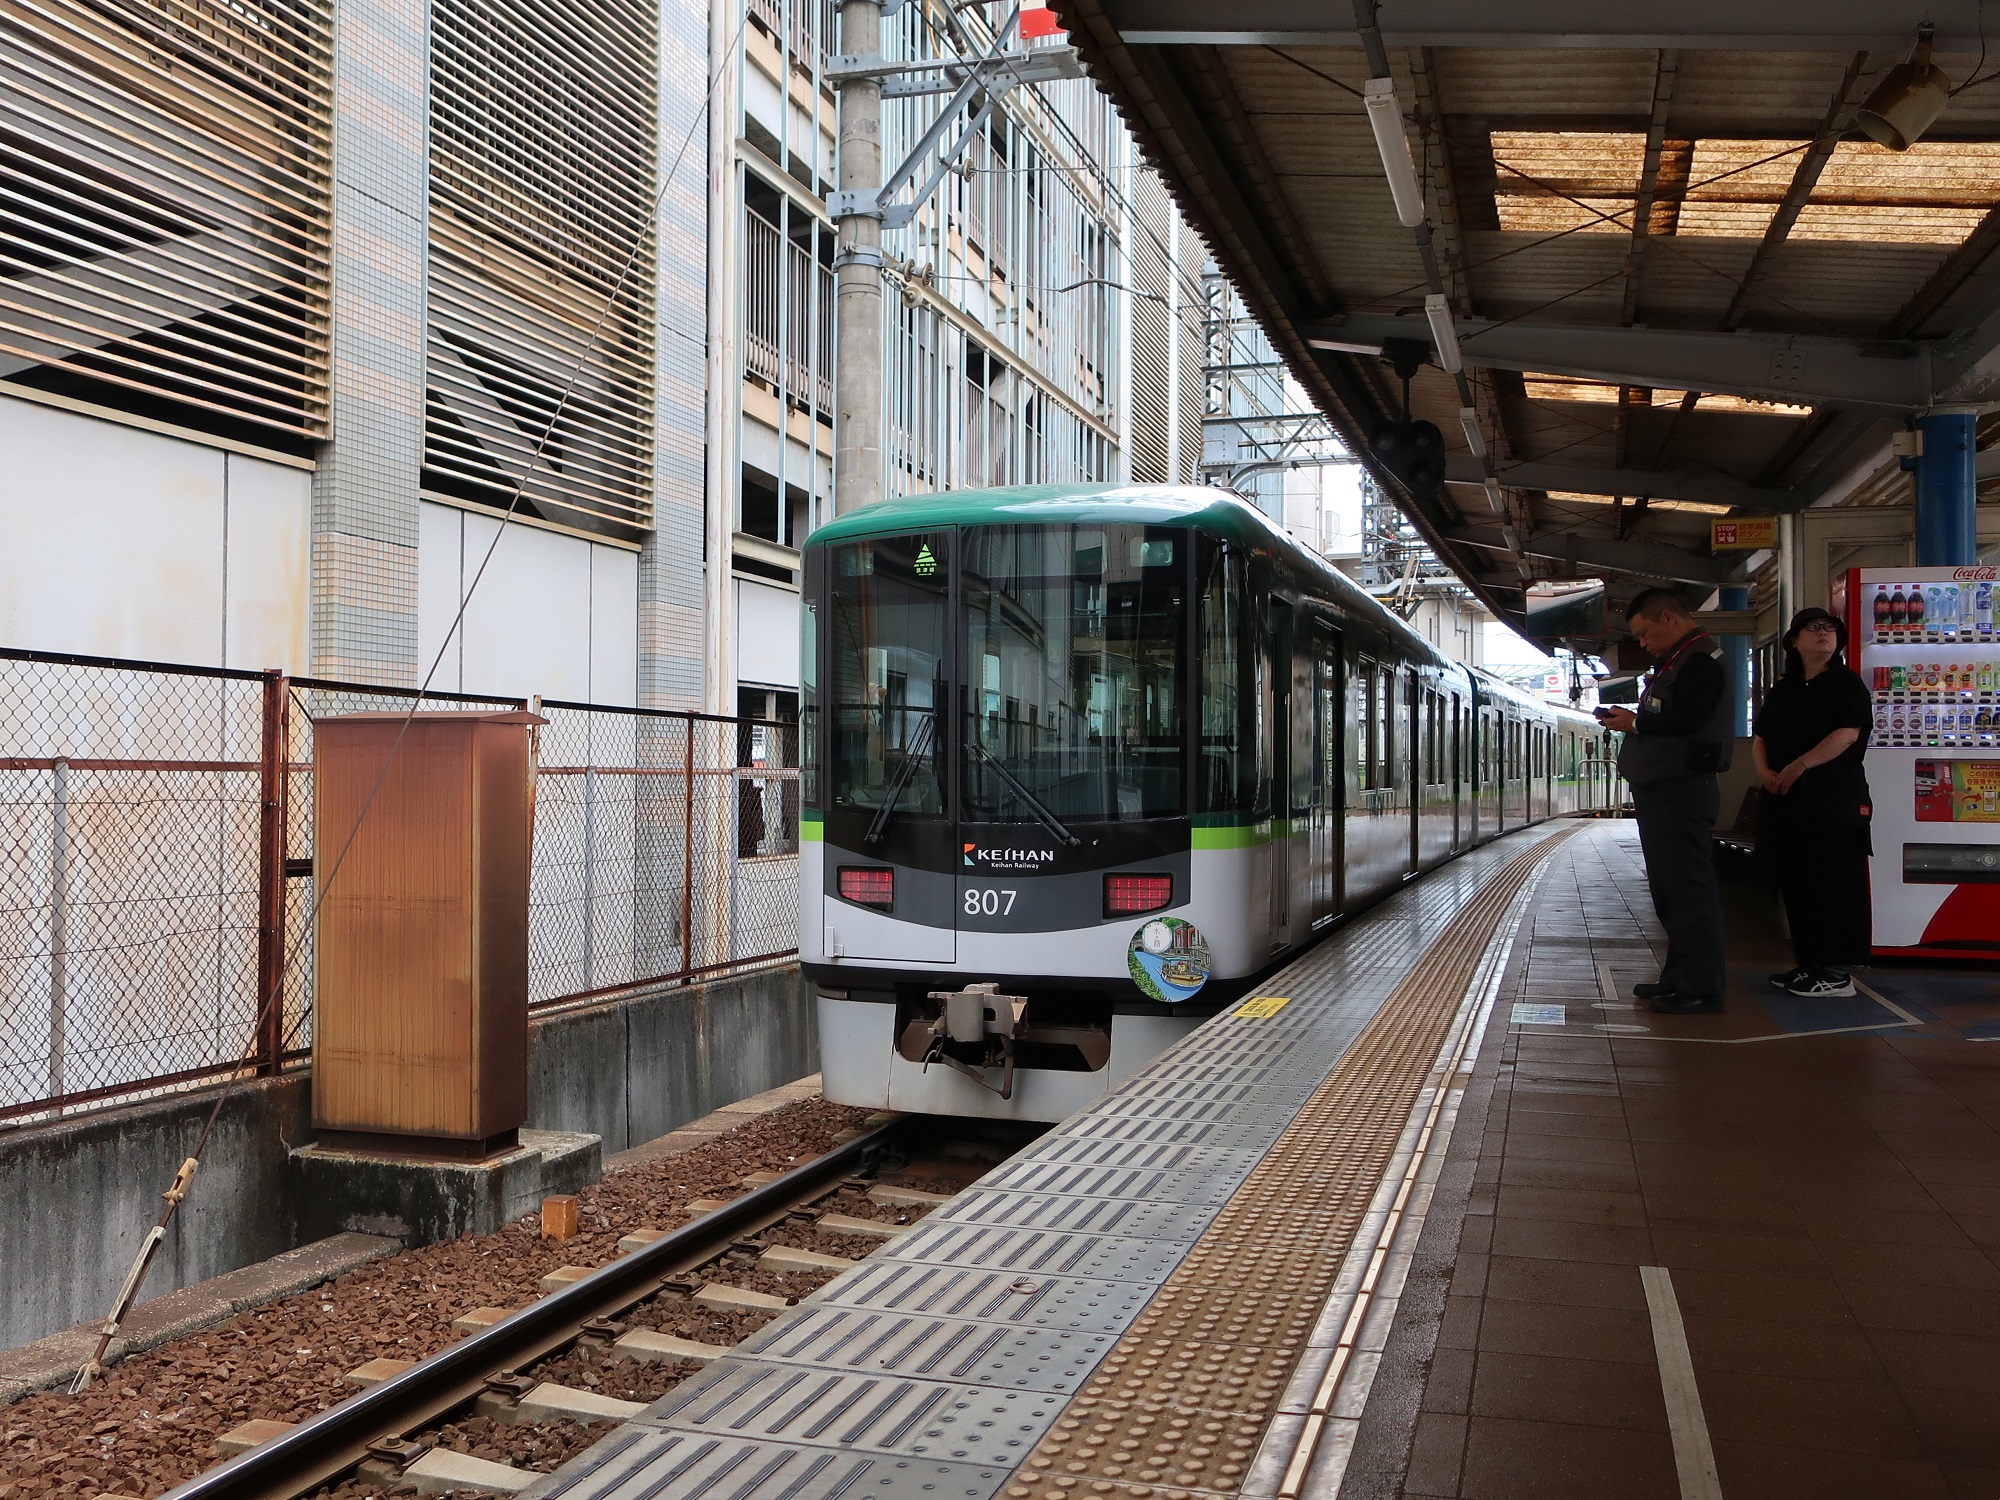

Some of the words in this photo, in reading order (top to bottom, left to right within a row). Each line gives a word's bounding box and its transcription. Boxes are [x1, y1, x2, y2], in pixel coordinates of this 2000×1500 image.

[1738, 530, 1762, 538] ボタン
[977, 848, 1055, 861] KEIHAN
[1014, 862, 1040, 870] Railway
[964, 889, 1017, 916] 807
